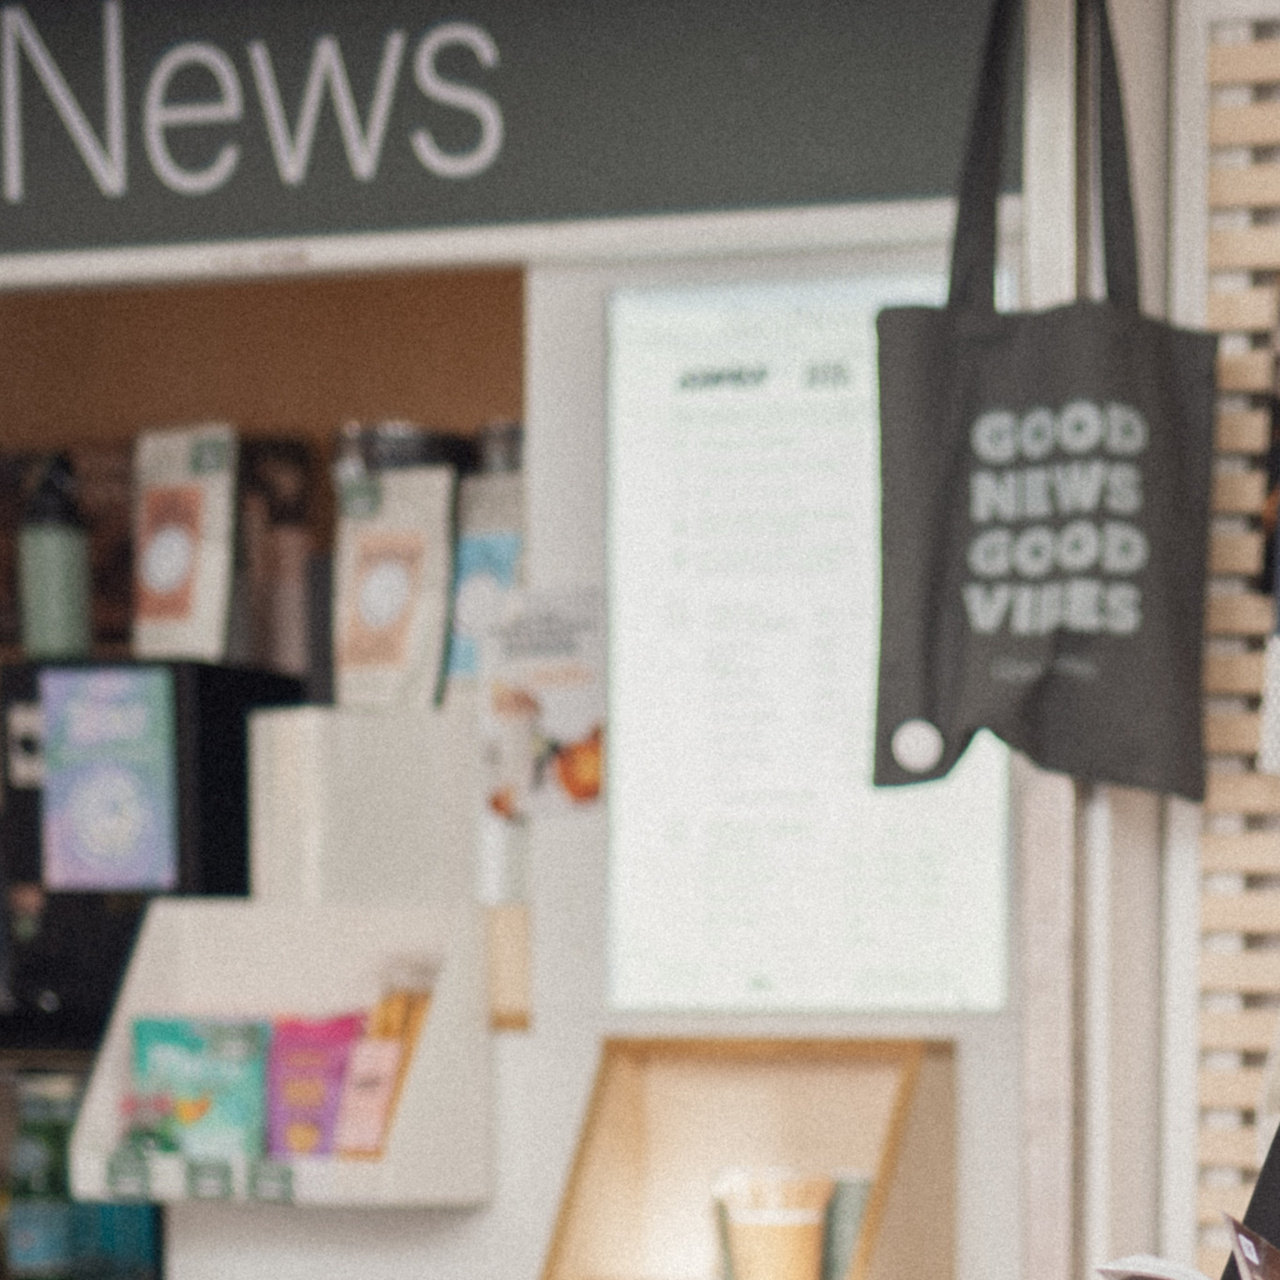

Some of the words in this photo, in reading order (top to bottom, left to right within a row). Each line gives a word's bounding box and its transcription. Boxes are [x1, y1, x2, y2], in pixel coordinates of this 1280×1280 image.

[0, 0, 505, 198] News
[970, 401, 1148, 463] GOOD
[970, 461, 1142, 523] NEWS
[968, 520, 1149, 578] GOOD
[963, 579, 1141, 636] VIBES
